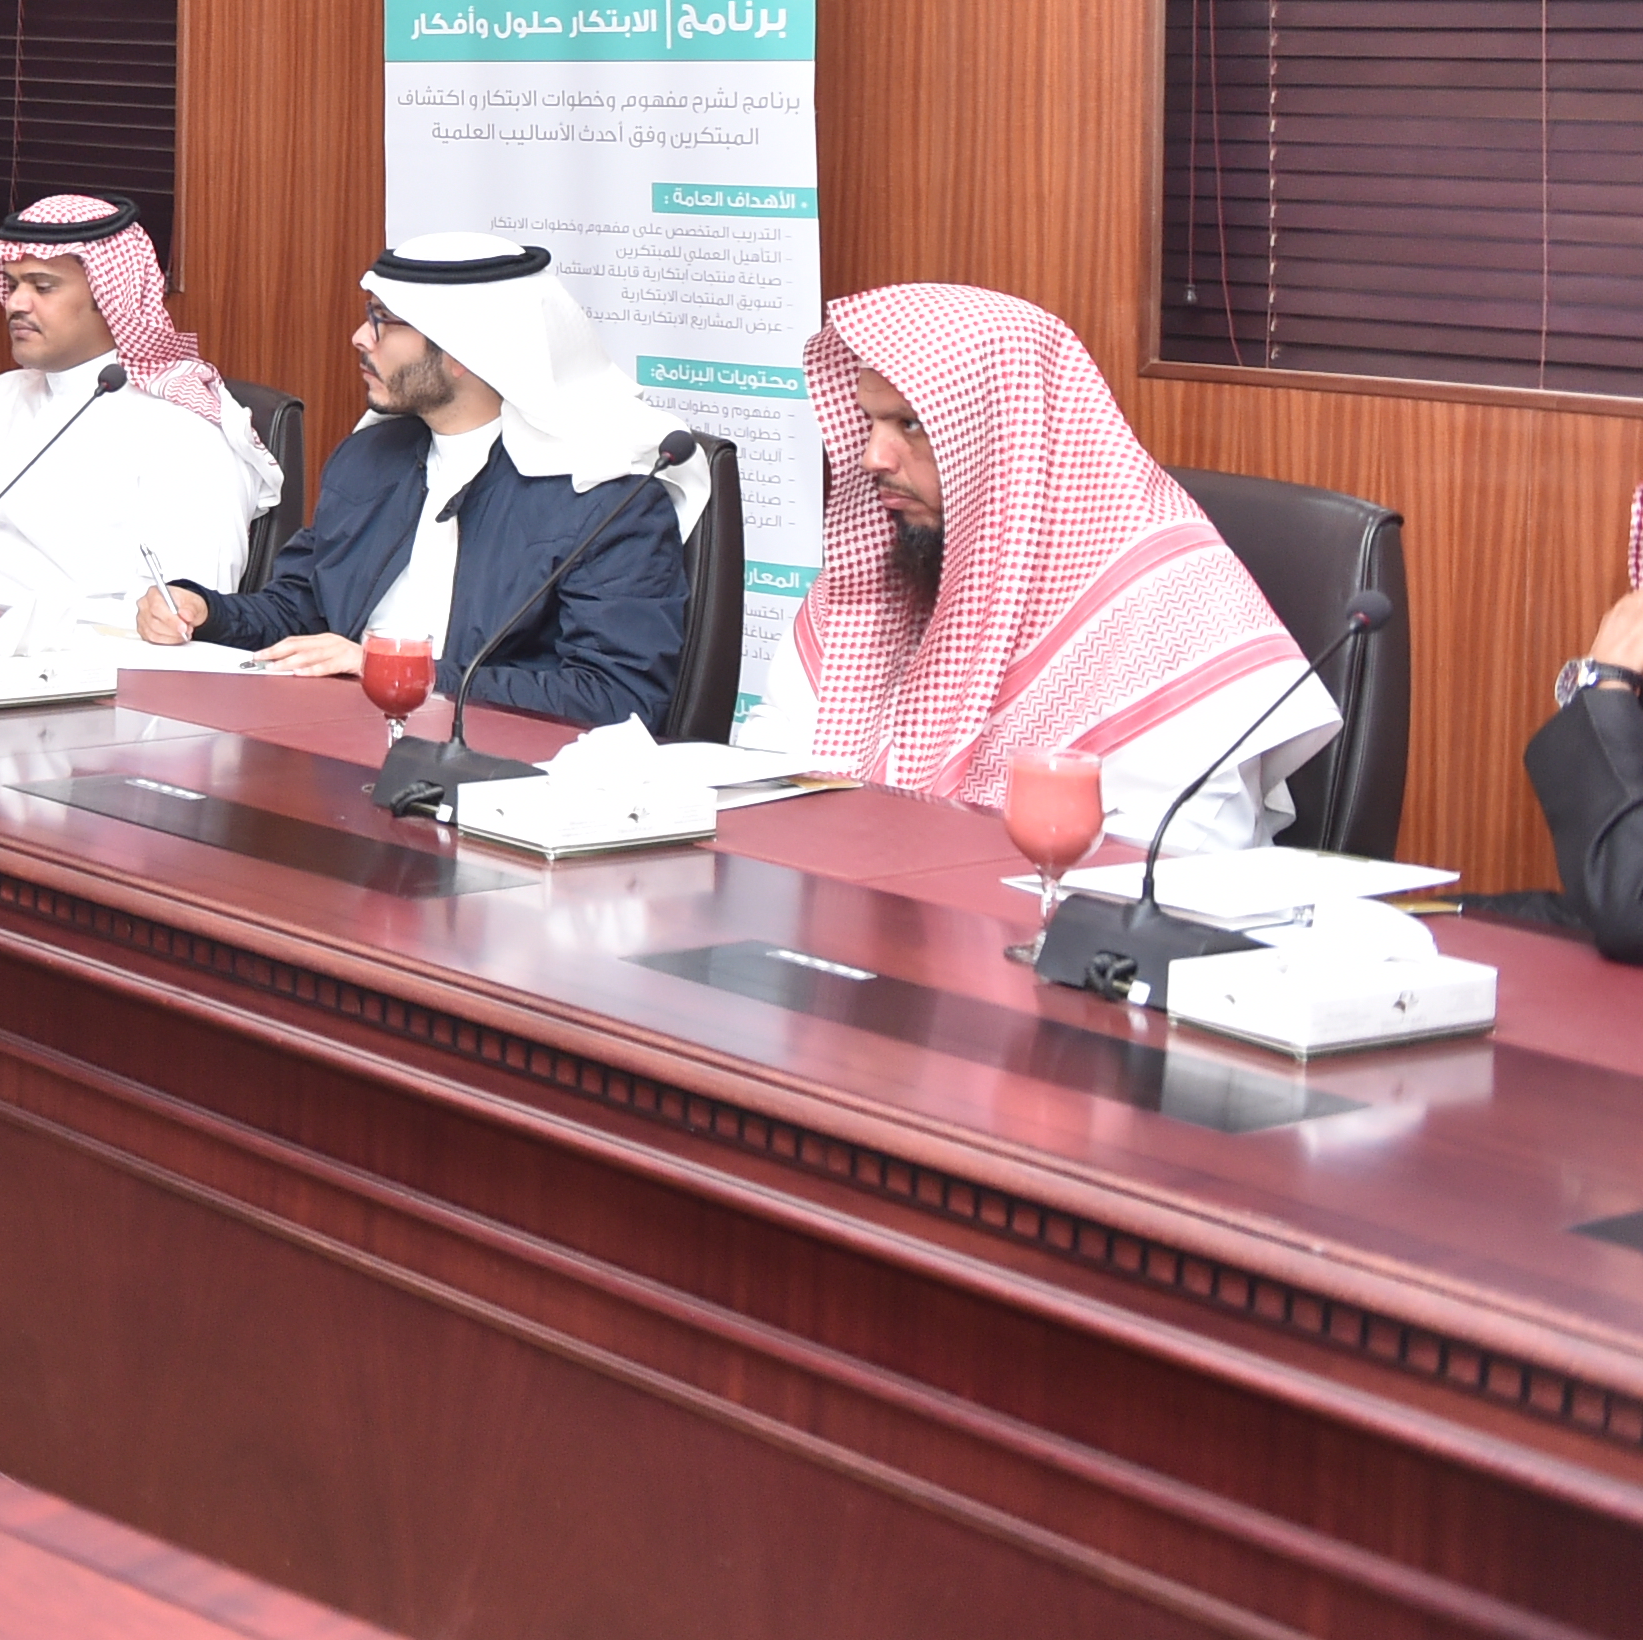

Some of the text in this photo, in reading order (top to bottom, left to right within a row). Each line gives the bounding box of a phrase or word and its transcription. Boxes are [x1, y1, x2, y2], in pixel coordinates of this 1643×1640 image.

[410, 0, 787, 40] برنامج الابتكار حلول وأفكار
[397, 86, 465, 106] اكتشاف
[542, 90, 616, 113] وخطوات
[620, 90, 688, 112] مفهوم
[692, 87, 738, 114] لشرح
[742, 91, 800, 114] برنامج
[431, 121, 759, 151] المبتكرين وفق أحدث الأساليب العلمية
[672, 187, 796, 210] الأهداف العامة
[490, 216, 781, 243] التدريب المتخصص على مفهوم وخطوات الابتكار
[615, 244, 782, 266] التأهيل العملي للمبتكرين
[555, 261, 782, 289] صياغة منتجات ابتكارية قابلة للاستثمار
[621, 287, 782, 311] تسويق المنتجات الابتكارية
[633, 309, 688, 328] الابتكارية
[690, 312, 743, 330] المشاريع
[745, 318, 783, 334] عرض
[717, 369, 799, 391] محتويات
[678, 399, 720, 414] خطوات
[731, 407, 782, 420] مفهوم
[734, 426, 782, 442] خطوات
[747, 567, 800, 589] المعار
